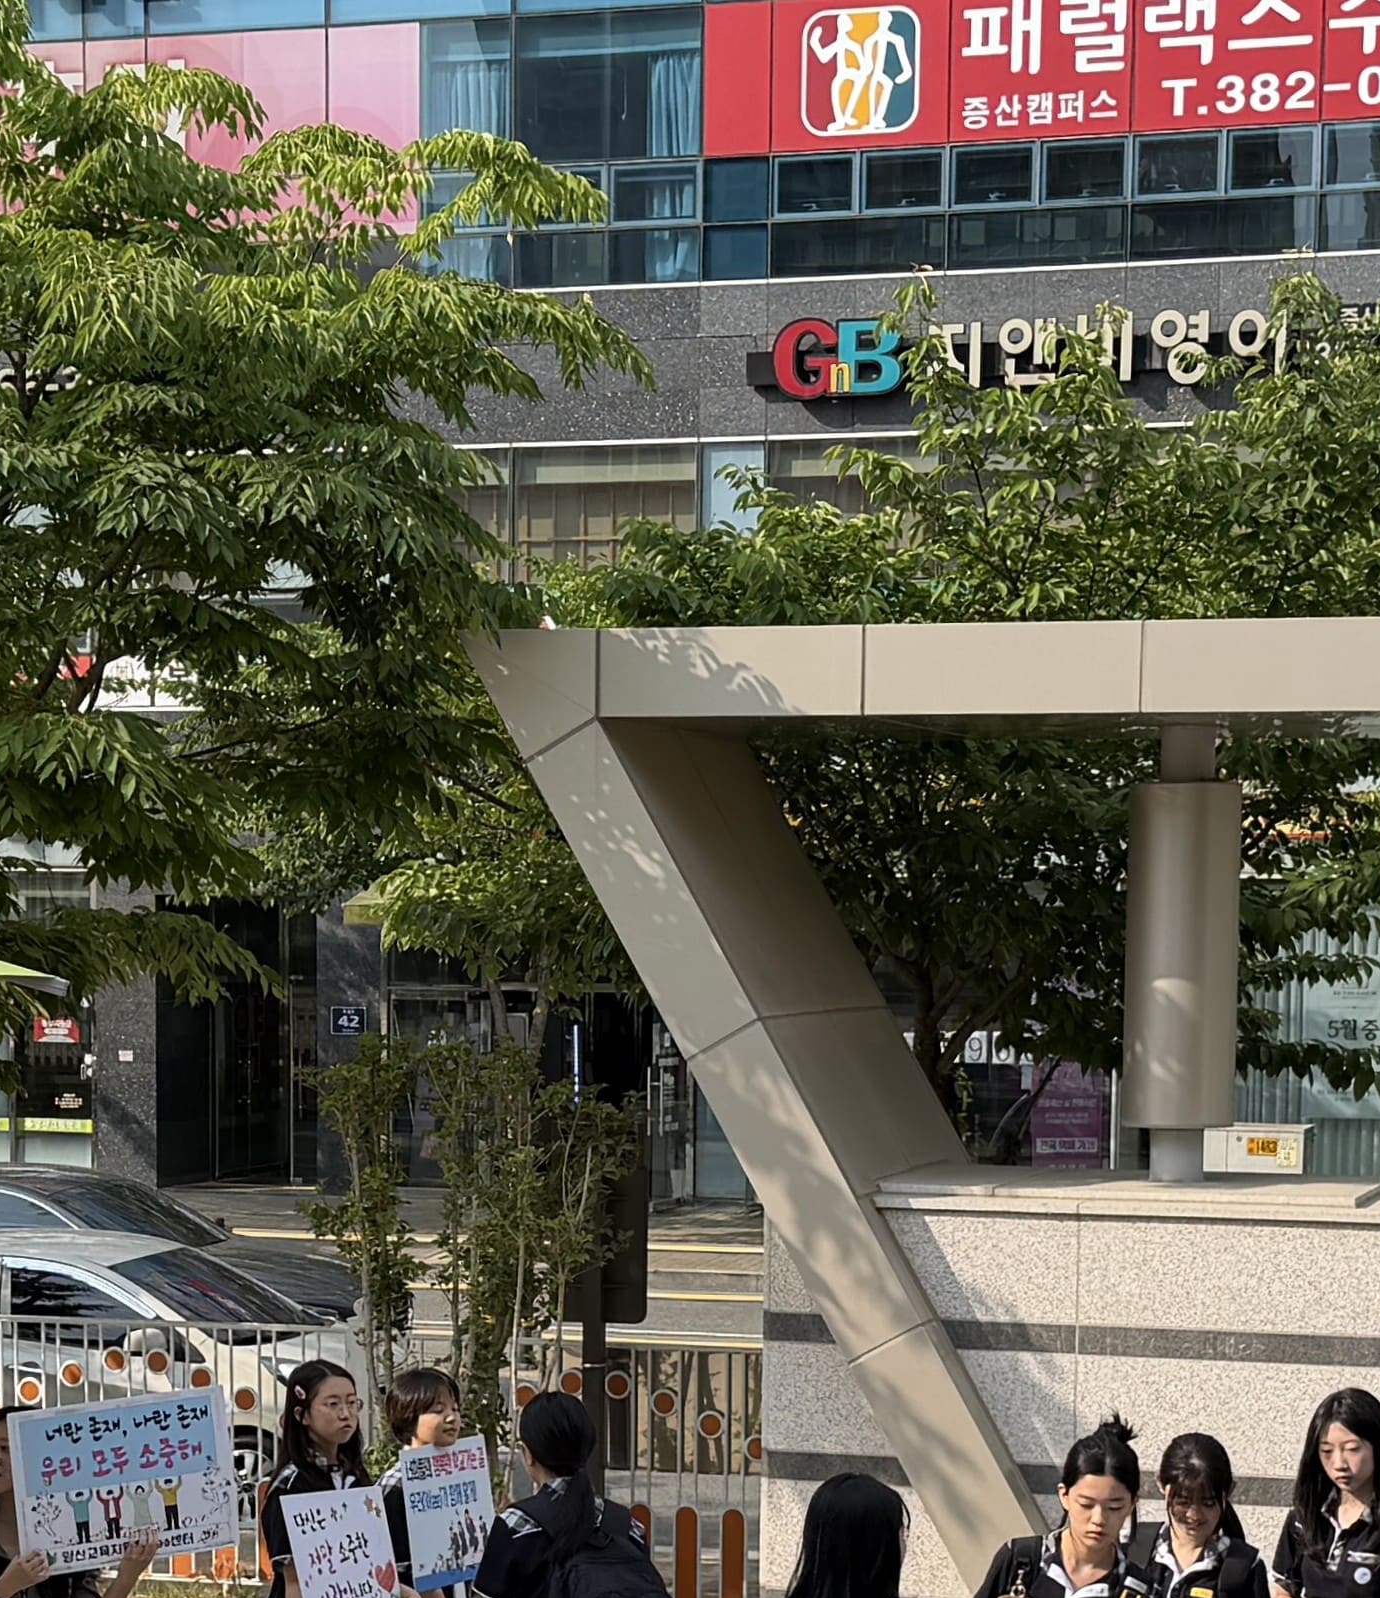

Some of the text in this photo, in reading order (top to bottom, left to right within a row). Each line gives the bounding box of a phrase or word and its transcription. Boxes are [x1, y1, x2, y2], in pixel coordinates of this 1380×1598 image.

[961, 89, 1118, 130] 증산캠퍼스
[338, 1015, 360, 1027] 42
[1327, 1018, 1380, 1041] 5월 중
[45, 1403, 209, 1444] 너란 존재, 나란 존재
[41, 1437, 203, 1486] 우리 모두 소중해
[293, 1508, 326, 1535] 당신은
[309, 1538, 337, 1575] 정말
